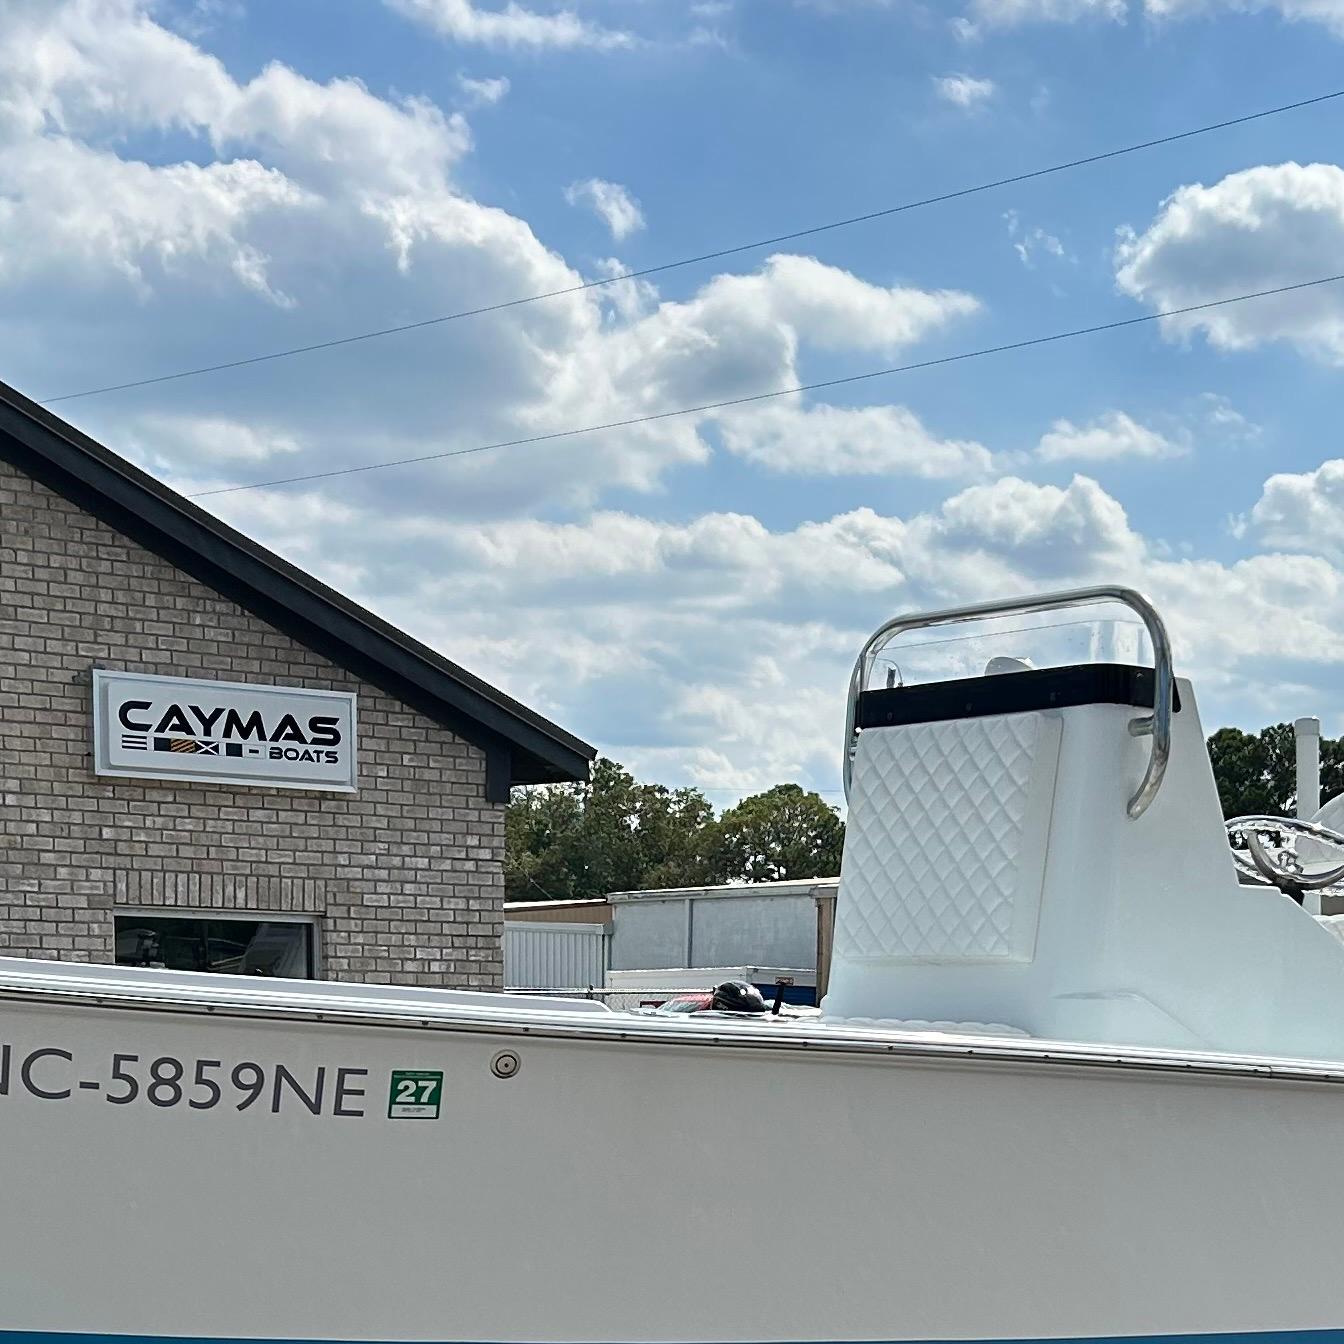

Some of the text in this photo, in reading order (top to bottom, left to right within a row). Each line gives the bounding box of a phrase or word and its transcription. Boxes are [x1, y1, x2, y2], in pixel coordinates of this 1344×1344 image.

[118, 700, 342, 744] CAYMAS
[268, 746, 339, 764] BOATS
[396, 1080, 437, 1103] 27
